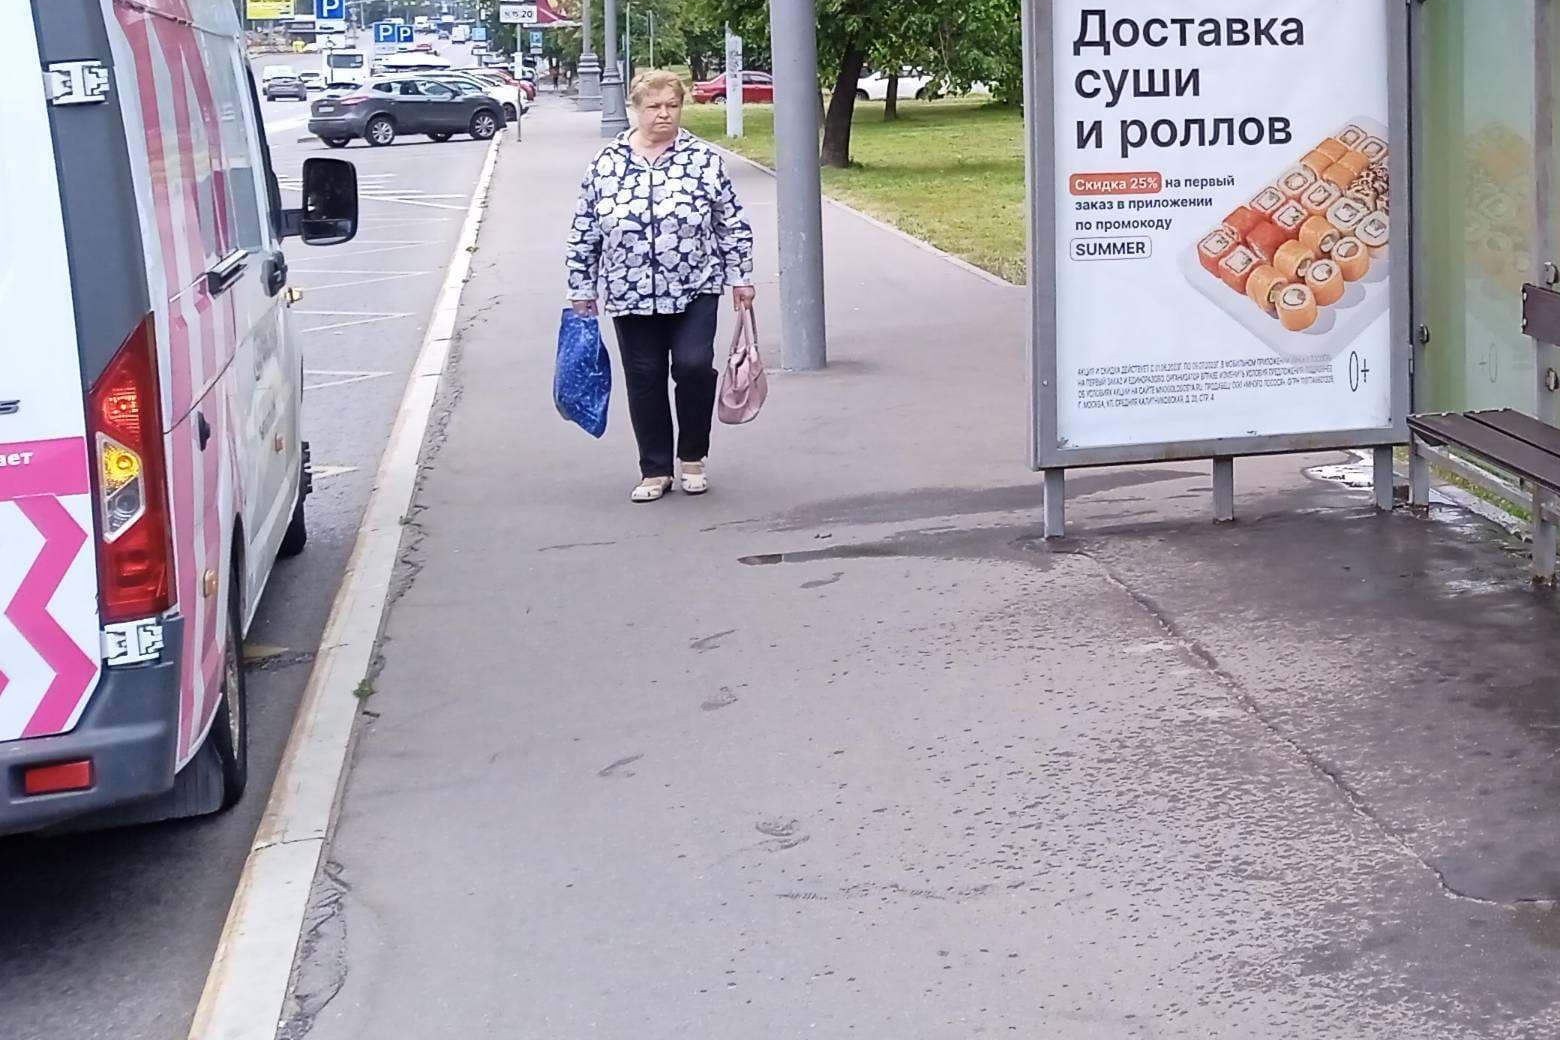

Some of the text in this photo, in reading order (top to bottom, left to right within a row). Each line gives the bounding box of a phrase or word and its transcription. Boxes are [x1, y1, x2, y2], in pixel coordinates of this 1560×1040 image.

[1073, 9, 1305, 56] Доставка
[1074, 67, 1200, 108] суши
[1076, 116, 1292, 158] и роллов
[1075, 175, 1235, 192] Скидка 25% на первый
[1075, 198, 1213, 211] заказ в приложении
[1076, 218, 1172, 232] по промокоду
[1075, 241, 1146, 256] SUMMER
[1349, 350, 1370, 392] 0+
